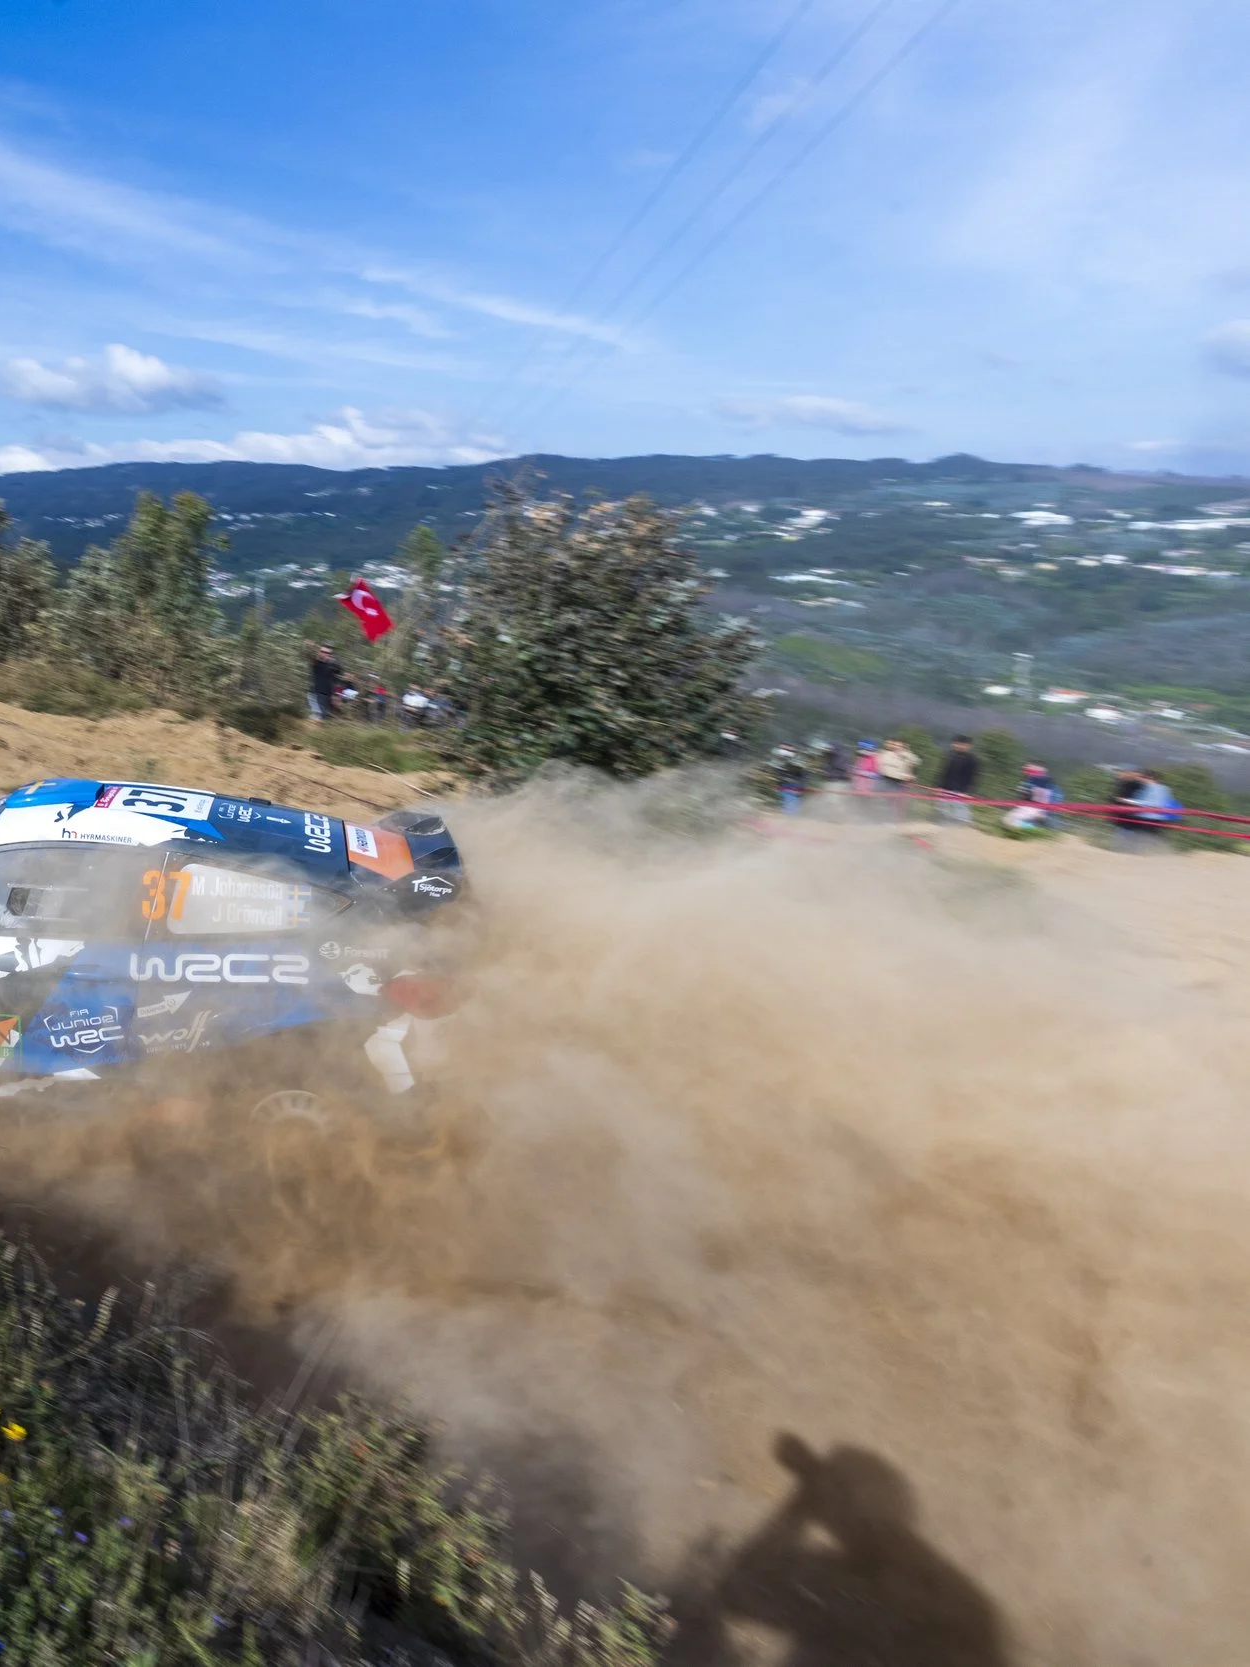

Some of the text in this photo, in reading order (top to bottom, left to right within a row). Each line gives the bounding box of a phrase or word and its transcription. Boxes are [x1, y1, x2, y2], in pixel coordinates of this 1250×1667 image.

[122, 789, 188, 813] 37
[80, 833, 132, 844] HYRMASKINER
[304, 812, 332, 853] WRC2
[141, 869, 192, 921] 37
[192, 876, 283, 899] M Johansson
[419, 883, 453, 894] Sjötorps
[211, 903, 283, 927] J Grönvall
[130, 953, 310, 984] WRC2
[51, 1014, 115, 1031] JUNIOR
[69, 1008, 89, 1017] FIA
[50, 1025, 124, 1047] WRC
